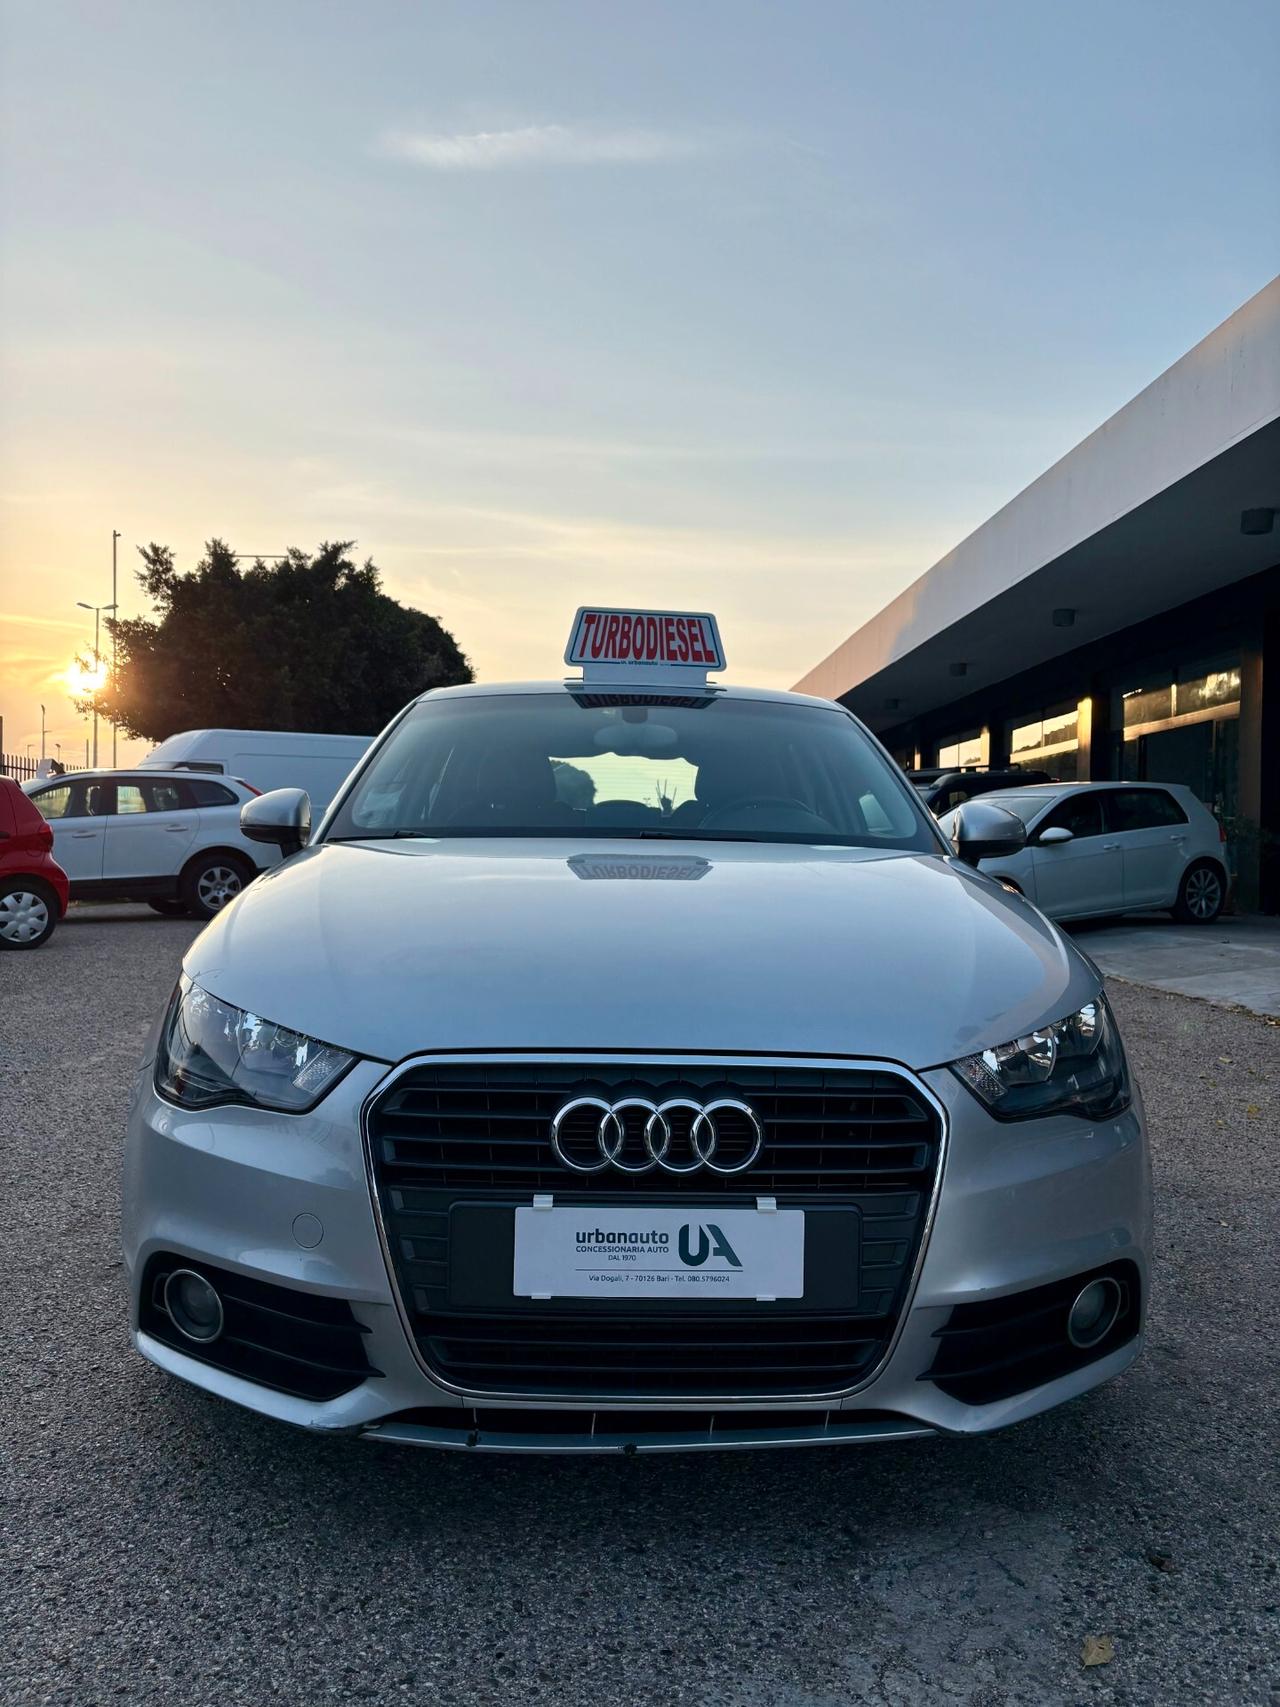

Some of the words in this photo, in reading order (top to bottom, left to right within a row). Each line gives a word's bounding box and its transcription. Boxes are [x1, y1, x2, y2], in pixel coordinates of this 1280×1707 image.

[579, 614, 716, 663] TURBODIESEL
[575, 1228, 669, 1244] urbanauto
[575, 1245, 646, 1253] CONCESSIONARIA
[601, 1275, 624, 1283] Dogali,
